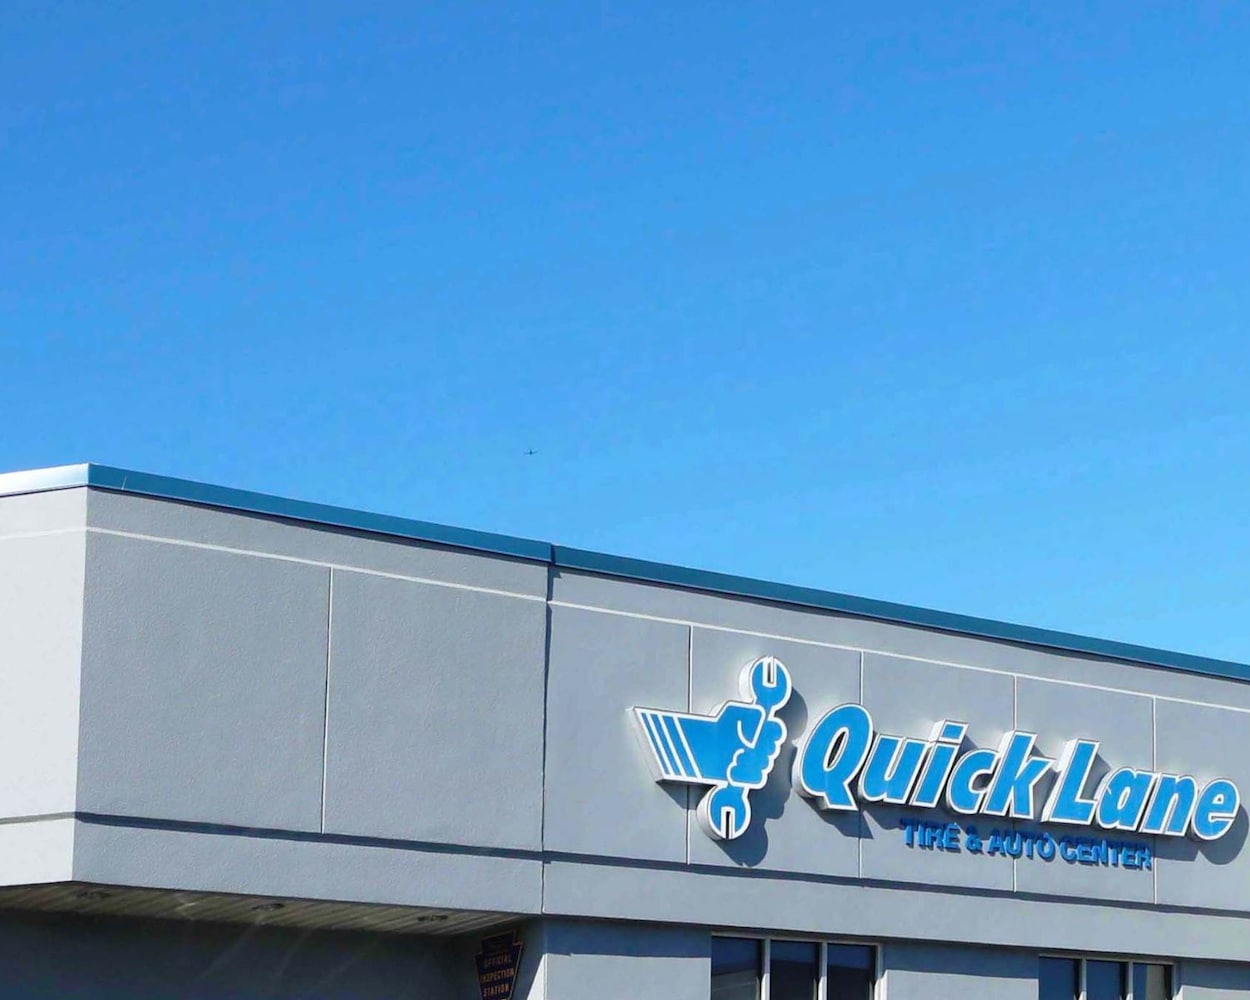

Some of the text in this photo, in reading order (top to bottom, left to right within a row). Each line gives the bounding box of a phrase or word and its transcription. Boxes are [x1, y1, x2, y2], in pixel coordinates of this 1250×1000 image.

[797, 703, 1240, 841] Quick Lane
[903, 822, 1154, 871] TIRE & AUTO CENTER
[483, 983, 510, 997] STATION
